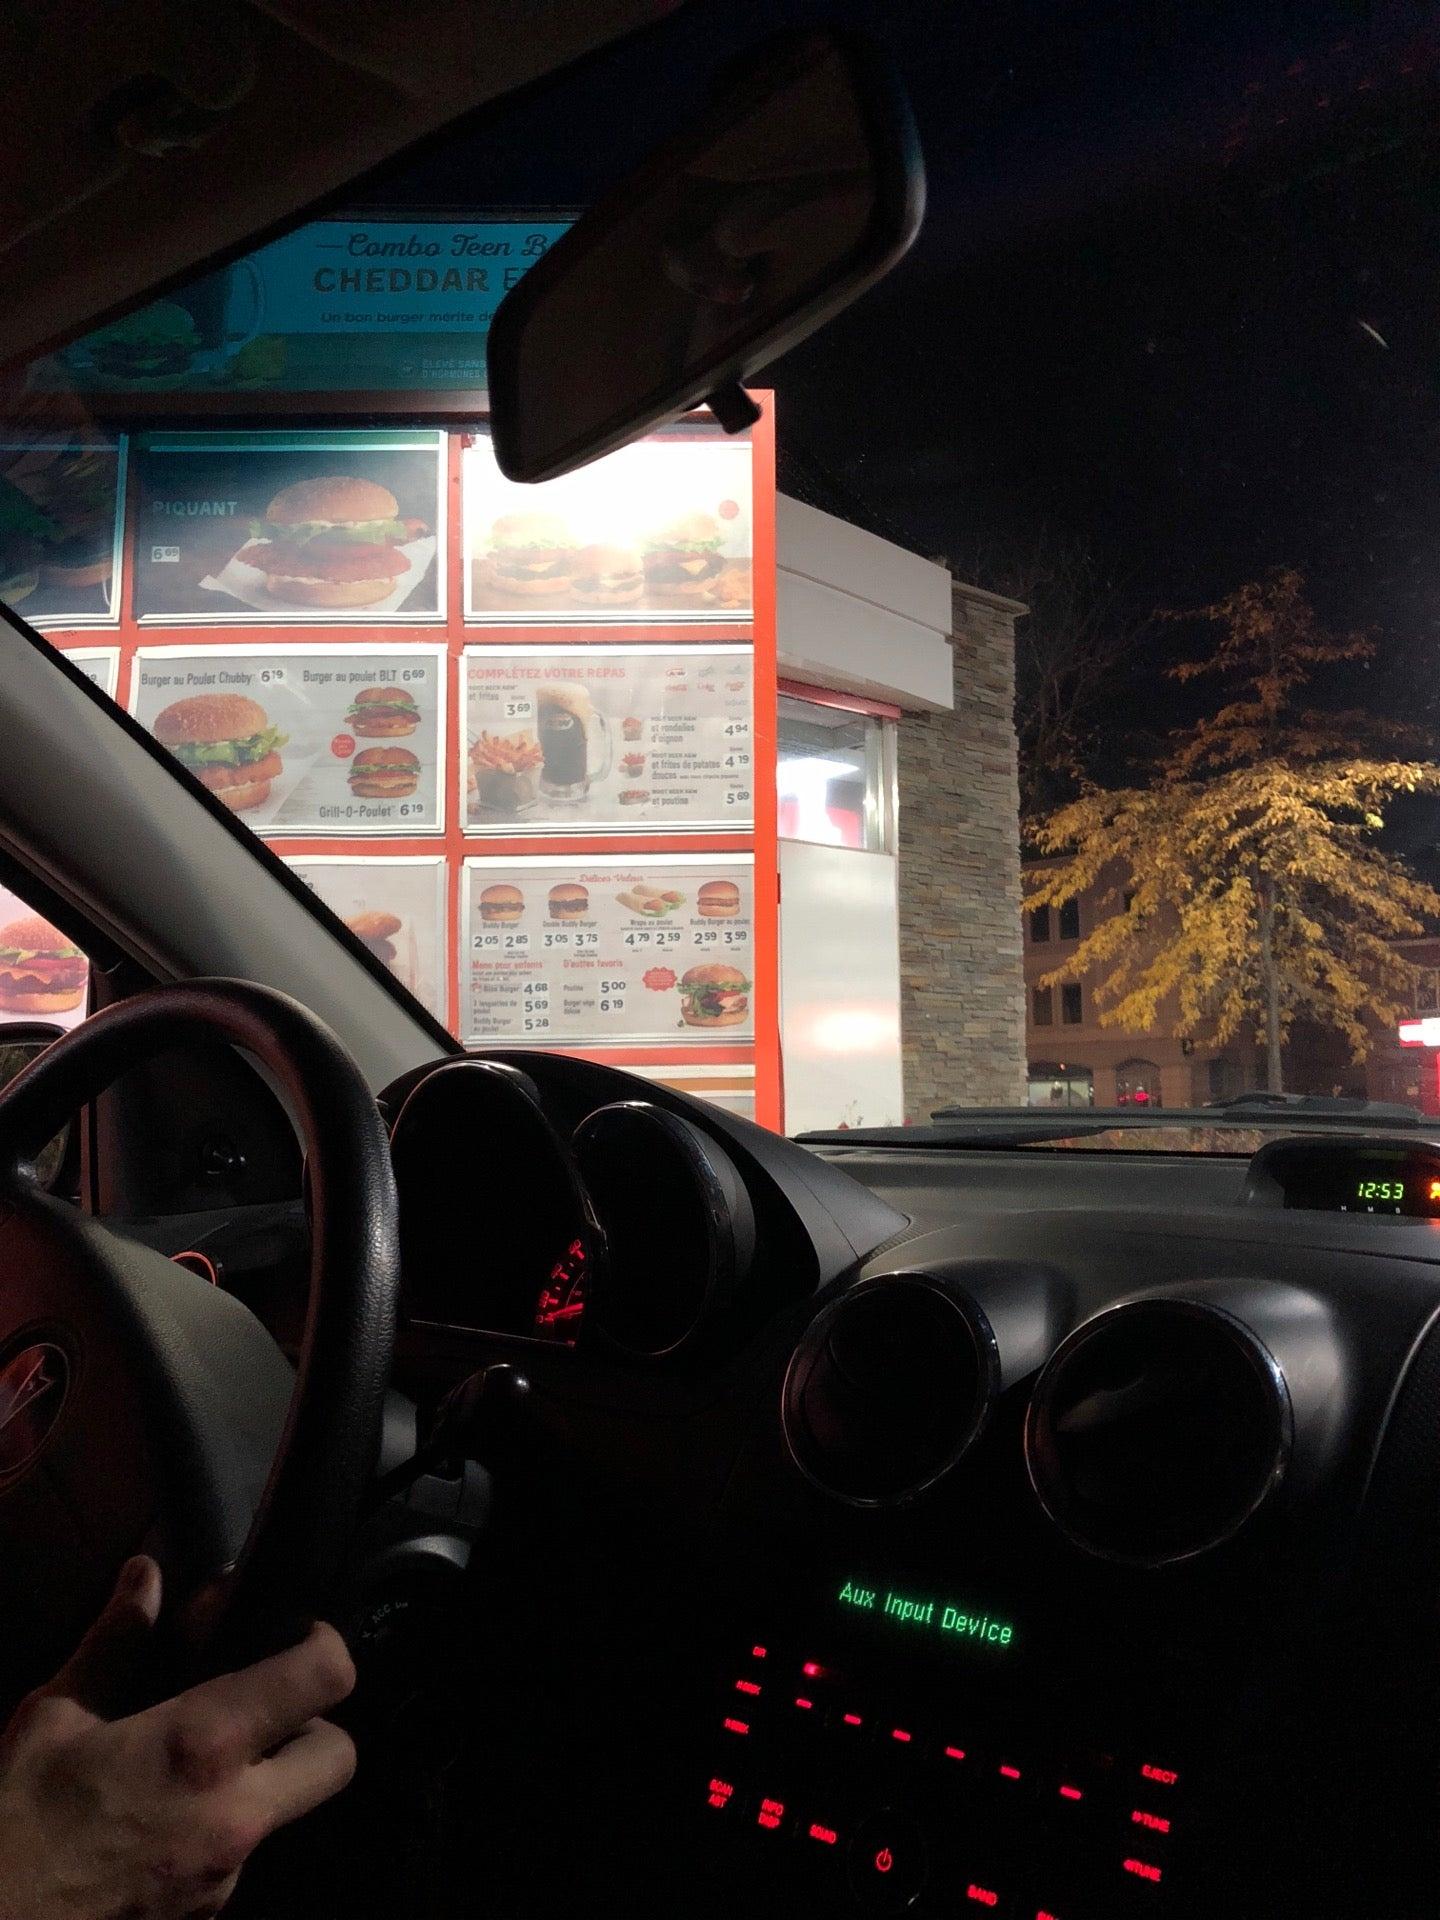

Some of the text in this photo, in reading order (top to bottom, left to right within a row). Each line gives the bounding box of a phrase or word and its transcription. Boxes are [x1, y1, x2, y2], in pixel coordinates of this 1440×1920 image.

[349, 233, 441, 257] Combo
[451, 233, 512, 257] Teen
[314, 267, 489, 293] CHEDDAR
[321, 312, 342, 324] Un
[344, 311, 373, 324] bon
[377, 311, 424, 326] burger
[152, 500, 238, 517] PIQUANT
[141, 671, 252, 688] Burger au Poulet Chubby
[303, 669, 397, 684] Burger au poulet BLT
[544, 667, 585, 679] VOTRE
[587, 667, 626, 679] REPAS
[1357, 1182, 1404, 1200] 12:53
[839, 1582, 1014, 1646] Aux Input Device
[1141, 1763, 1179, 1785] EJECT
